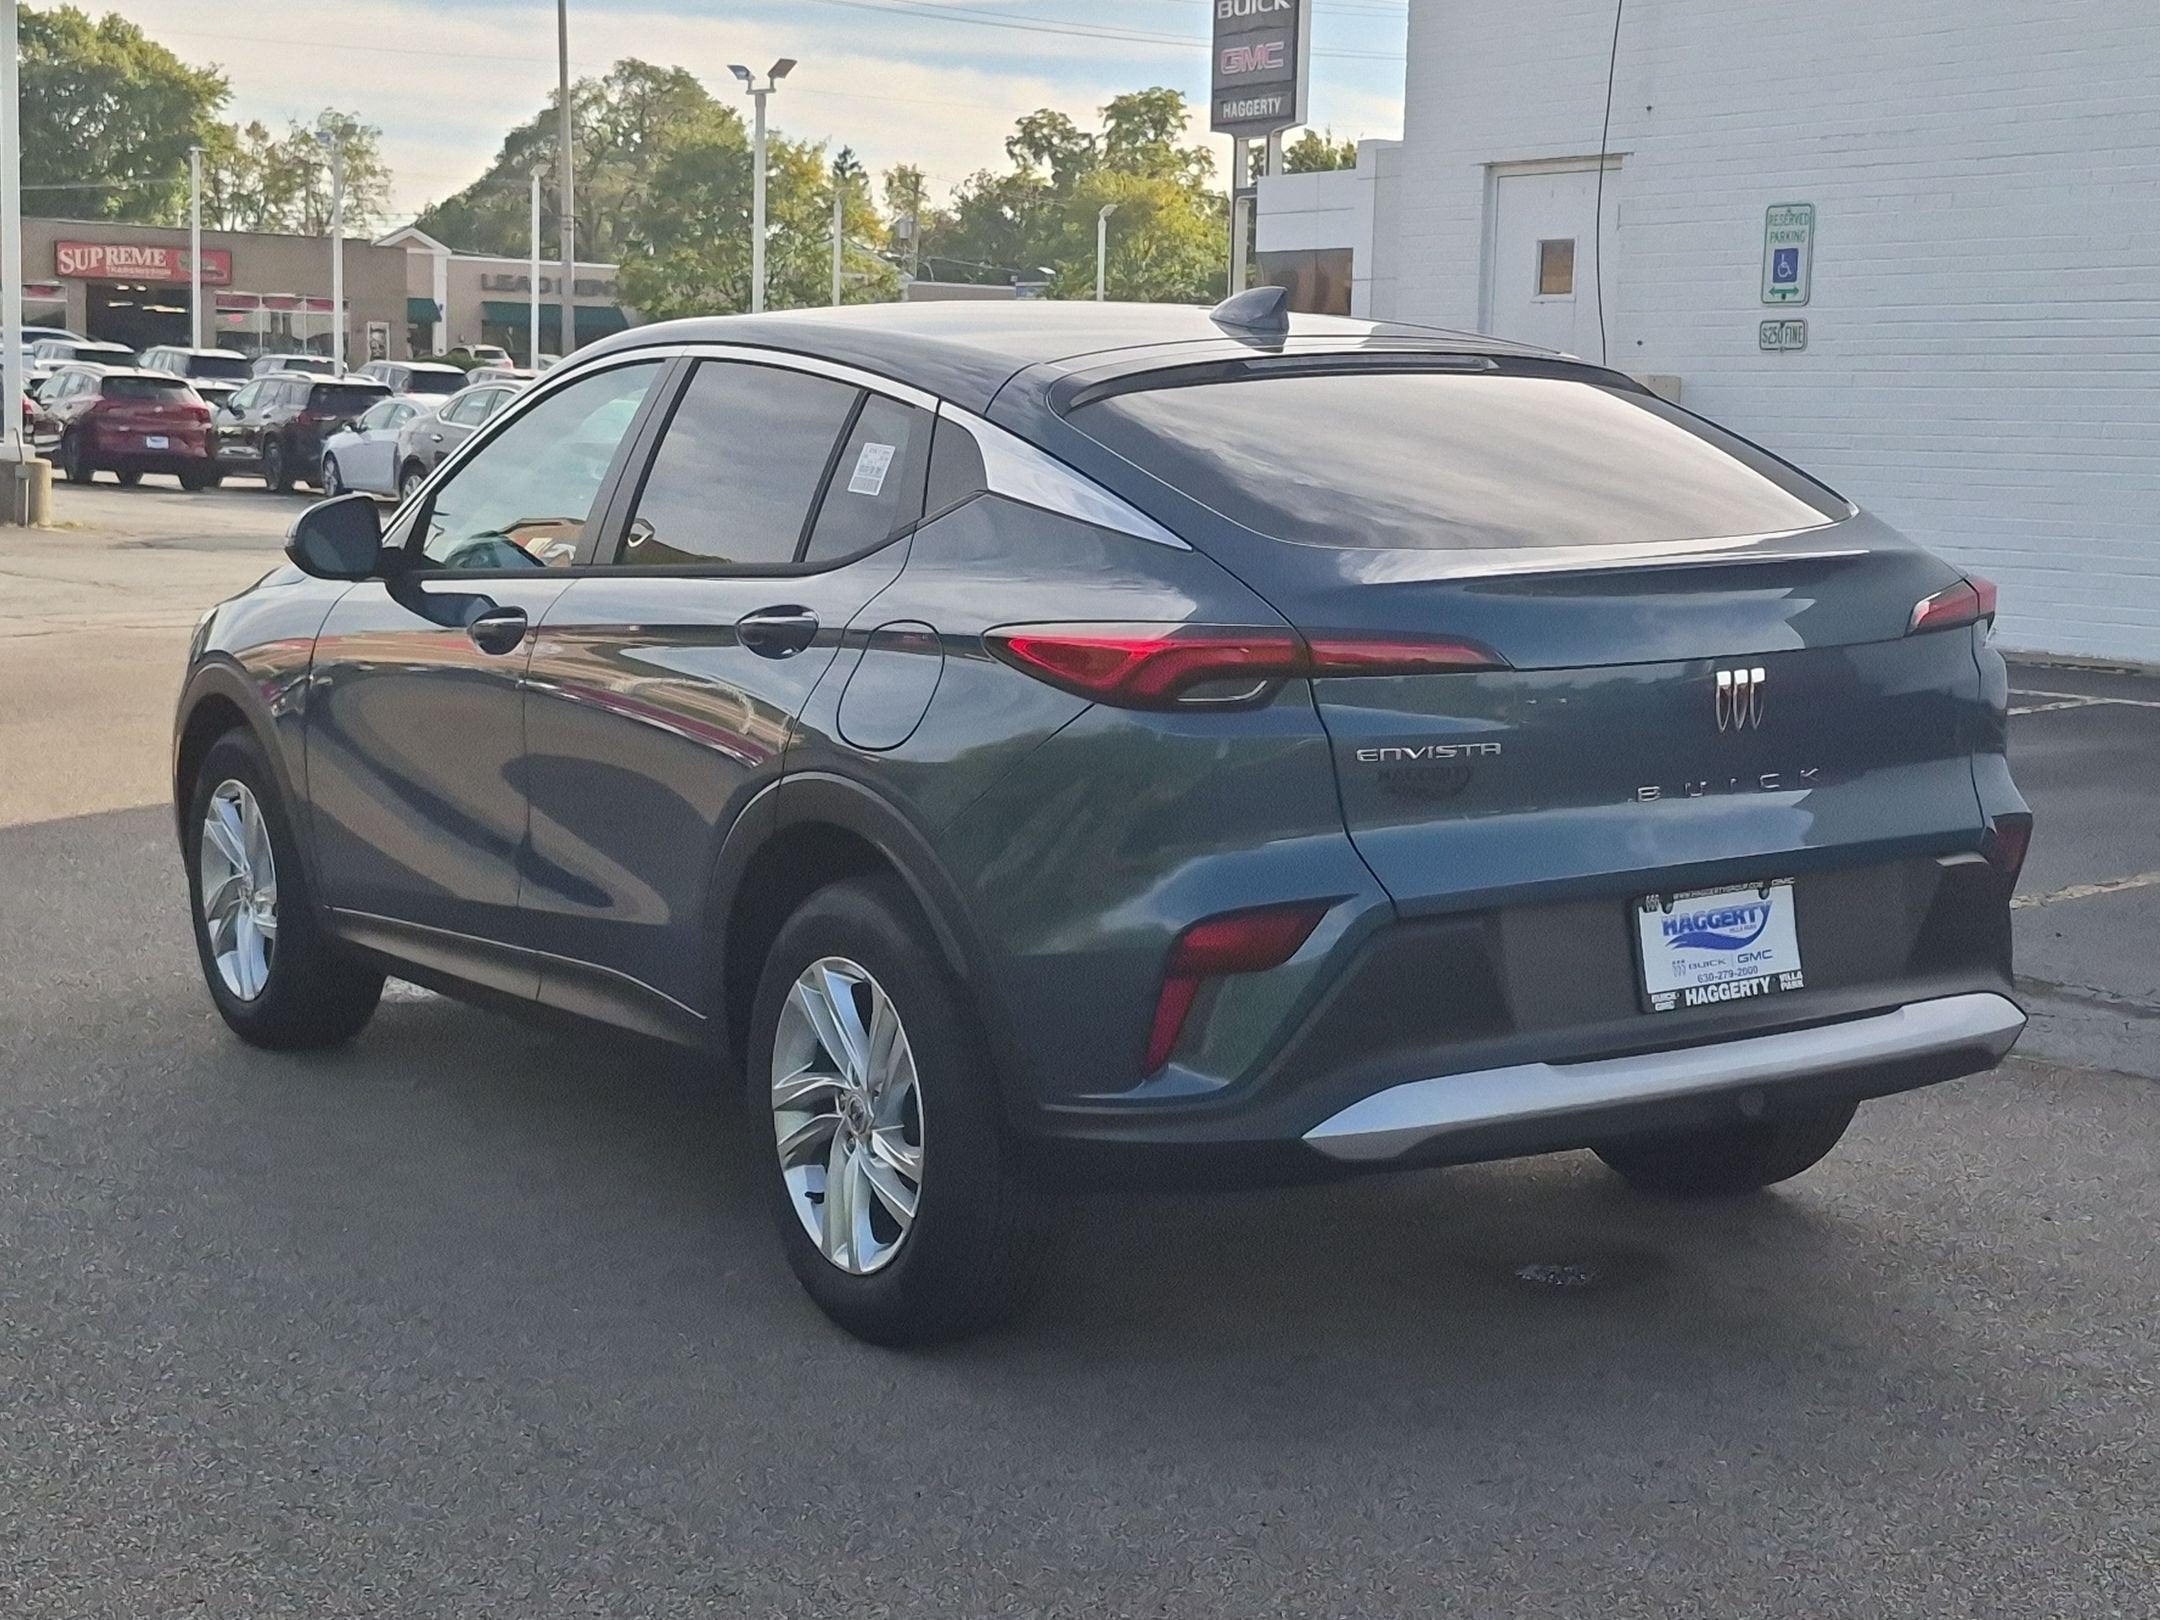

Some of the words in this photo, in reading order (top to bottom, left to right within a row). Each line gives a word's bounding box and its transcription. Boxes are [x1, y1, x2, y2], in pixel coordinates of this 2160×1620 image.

[1221, 41, 1285, 75] GMC
[1222, 96, 1281, 118] HAGGERTY
[1769, 212, 1809, 226] RESERVED
[1770, 230, 1806, 244] PARKING
[59, 246, 167, 274] SUPREME
[1784, 325, 1803, 344] FINE
[1356, 742, 1502, 762] ENVISTA
[1662, 901, 1773, 937] HAGGERTY
[1688, 959, 1727, 970] BUICK
[1737, 949, 1773, 964] GMC
[1697, 964, 1759, 983] 630-279-2000
[1685, 976, 1771, 1007] HAGGERTY
